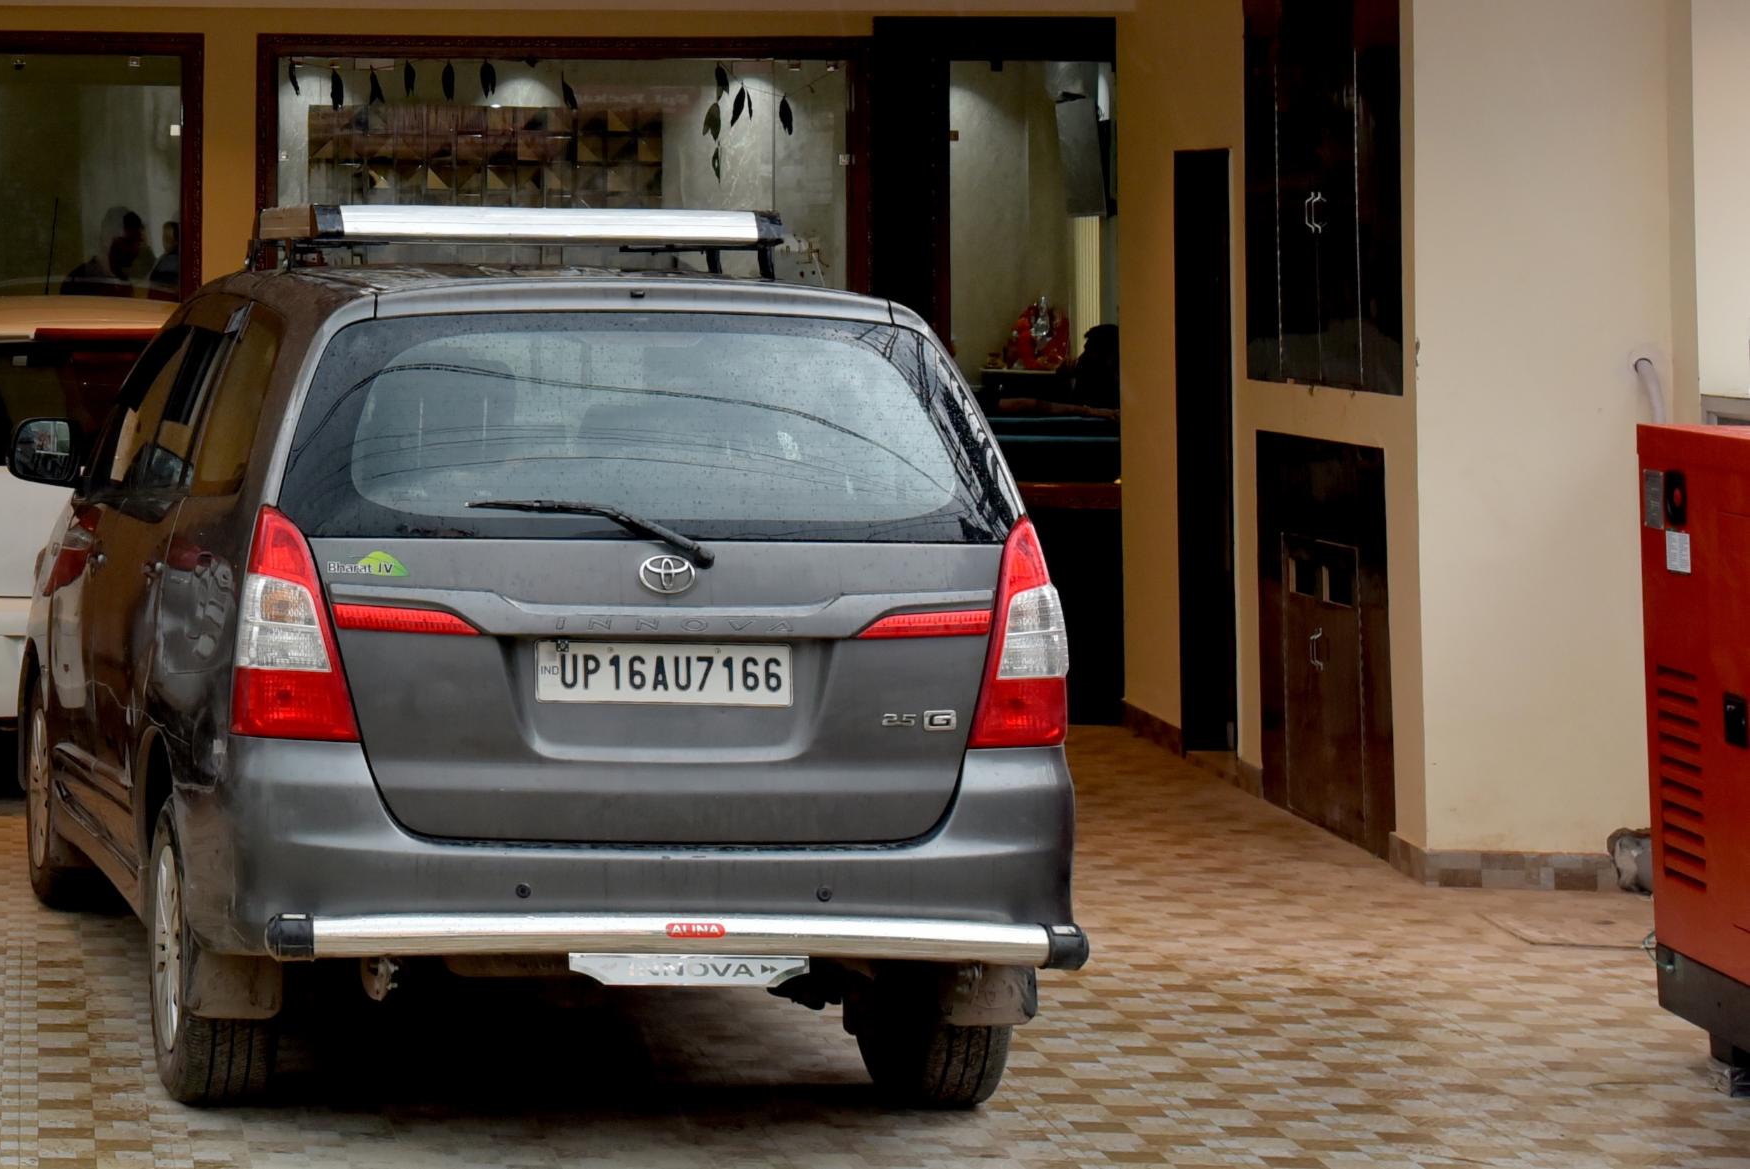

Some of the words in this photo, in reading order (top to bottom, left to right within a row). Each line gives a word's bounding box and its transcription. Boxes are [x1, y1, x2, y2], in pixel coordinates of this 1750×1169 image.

[327, 561, 372, 574] Bharat
[555, 616, 795, 632] INNOVA
[540, 665, 560, 676] IND
[559, 654, 783, 693] UP16AU7166
